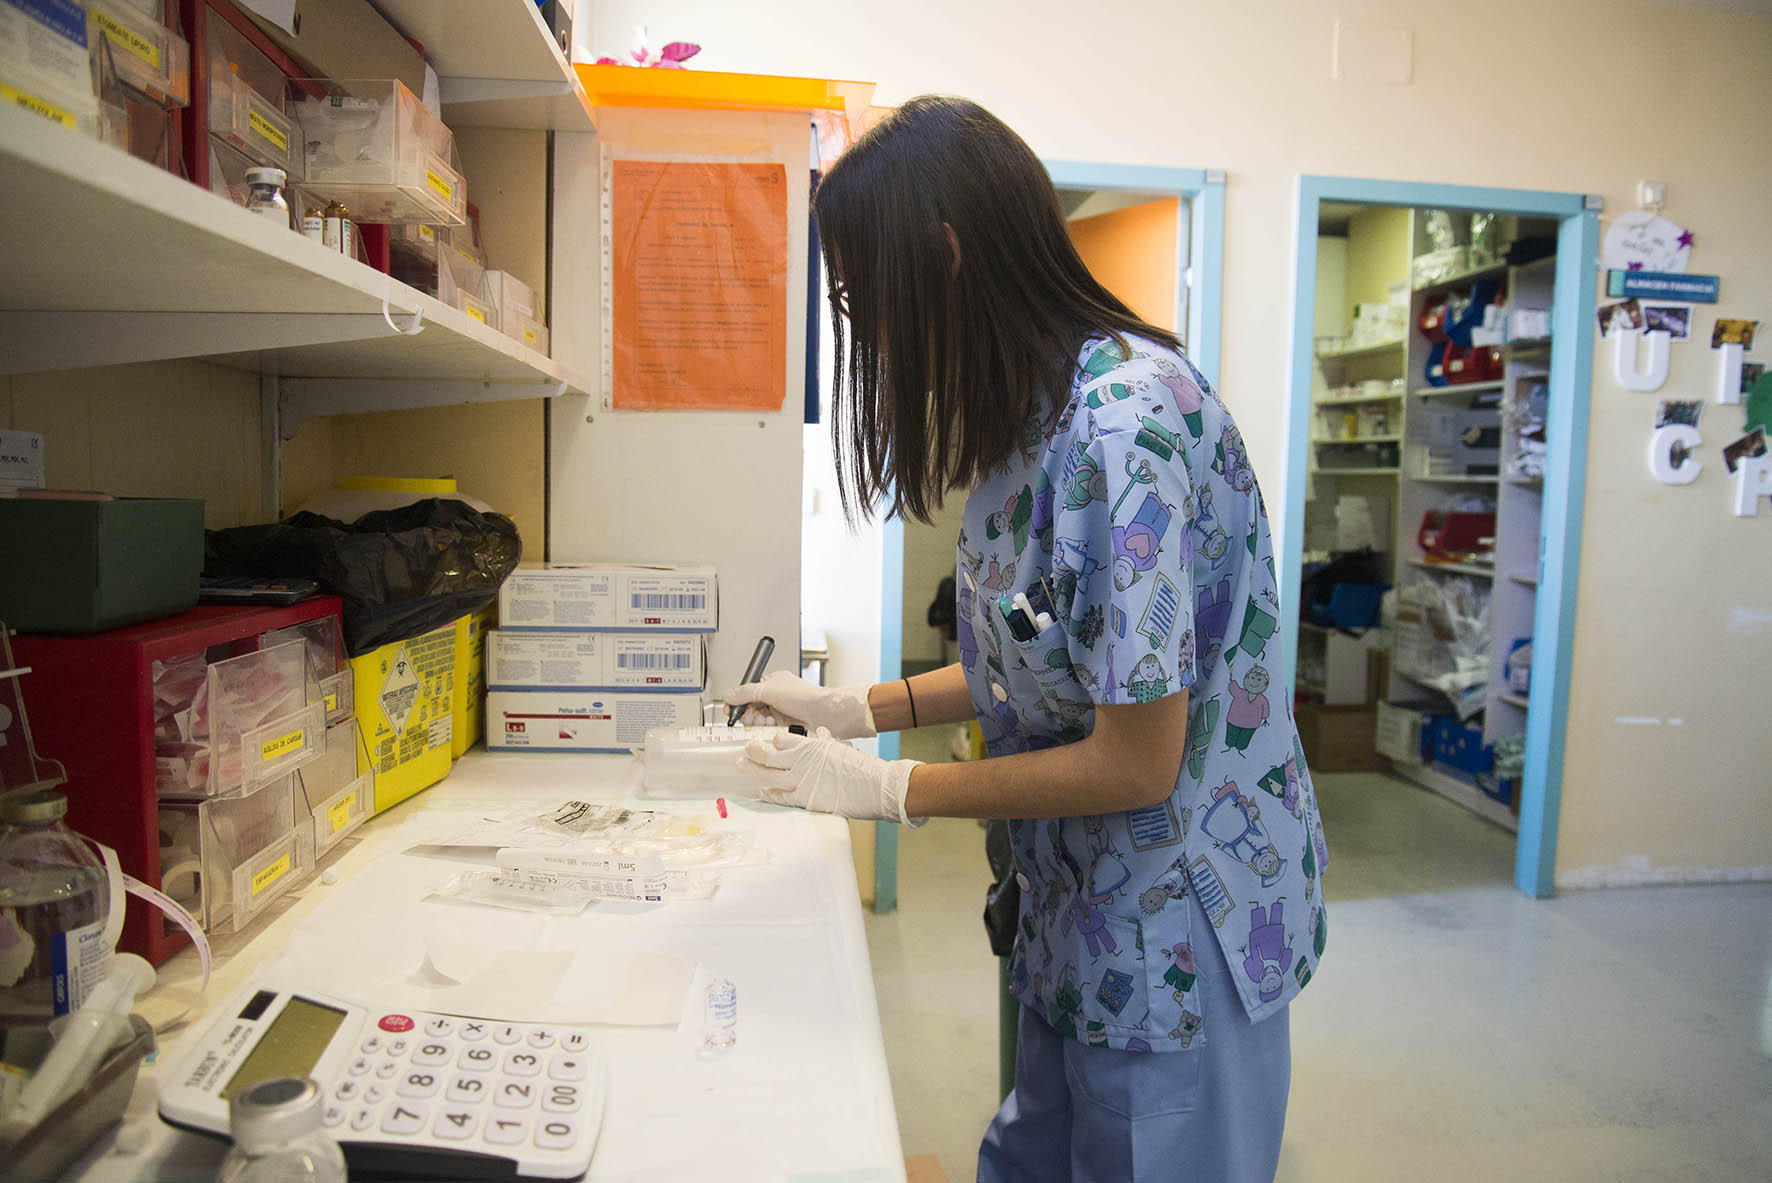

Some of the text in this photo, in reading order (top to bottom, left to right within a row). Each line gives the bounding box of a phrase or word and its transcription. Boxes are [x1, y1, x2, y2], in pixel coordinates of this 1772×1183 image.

[1614, 329, 1744, 404] U I
[1649, 424, 1703, 485] C
[393, 1044, 447, 1120] 7 8 9
[446, 1049, 492, 1128] 4 5 6
[496, 1054, 537, 1130] 1 2 3
[545, 1086, 577, 1136] 0 00
